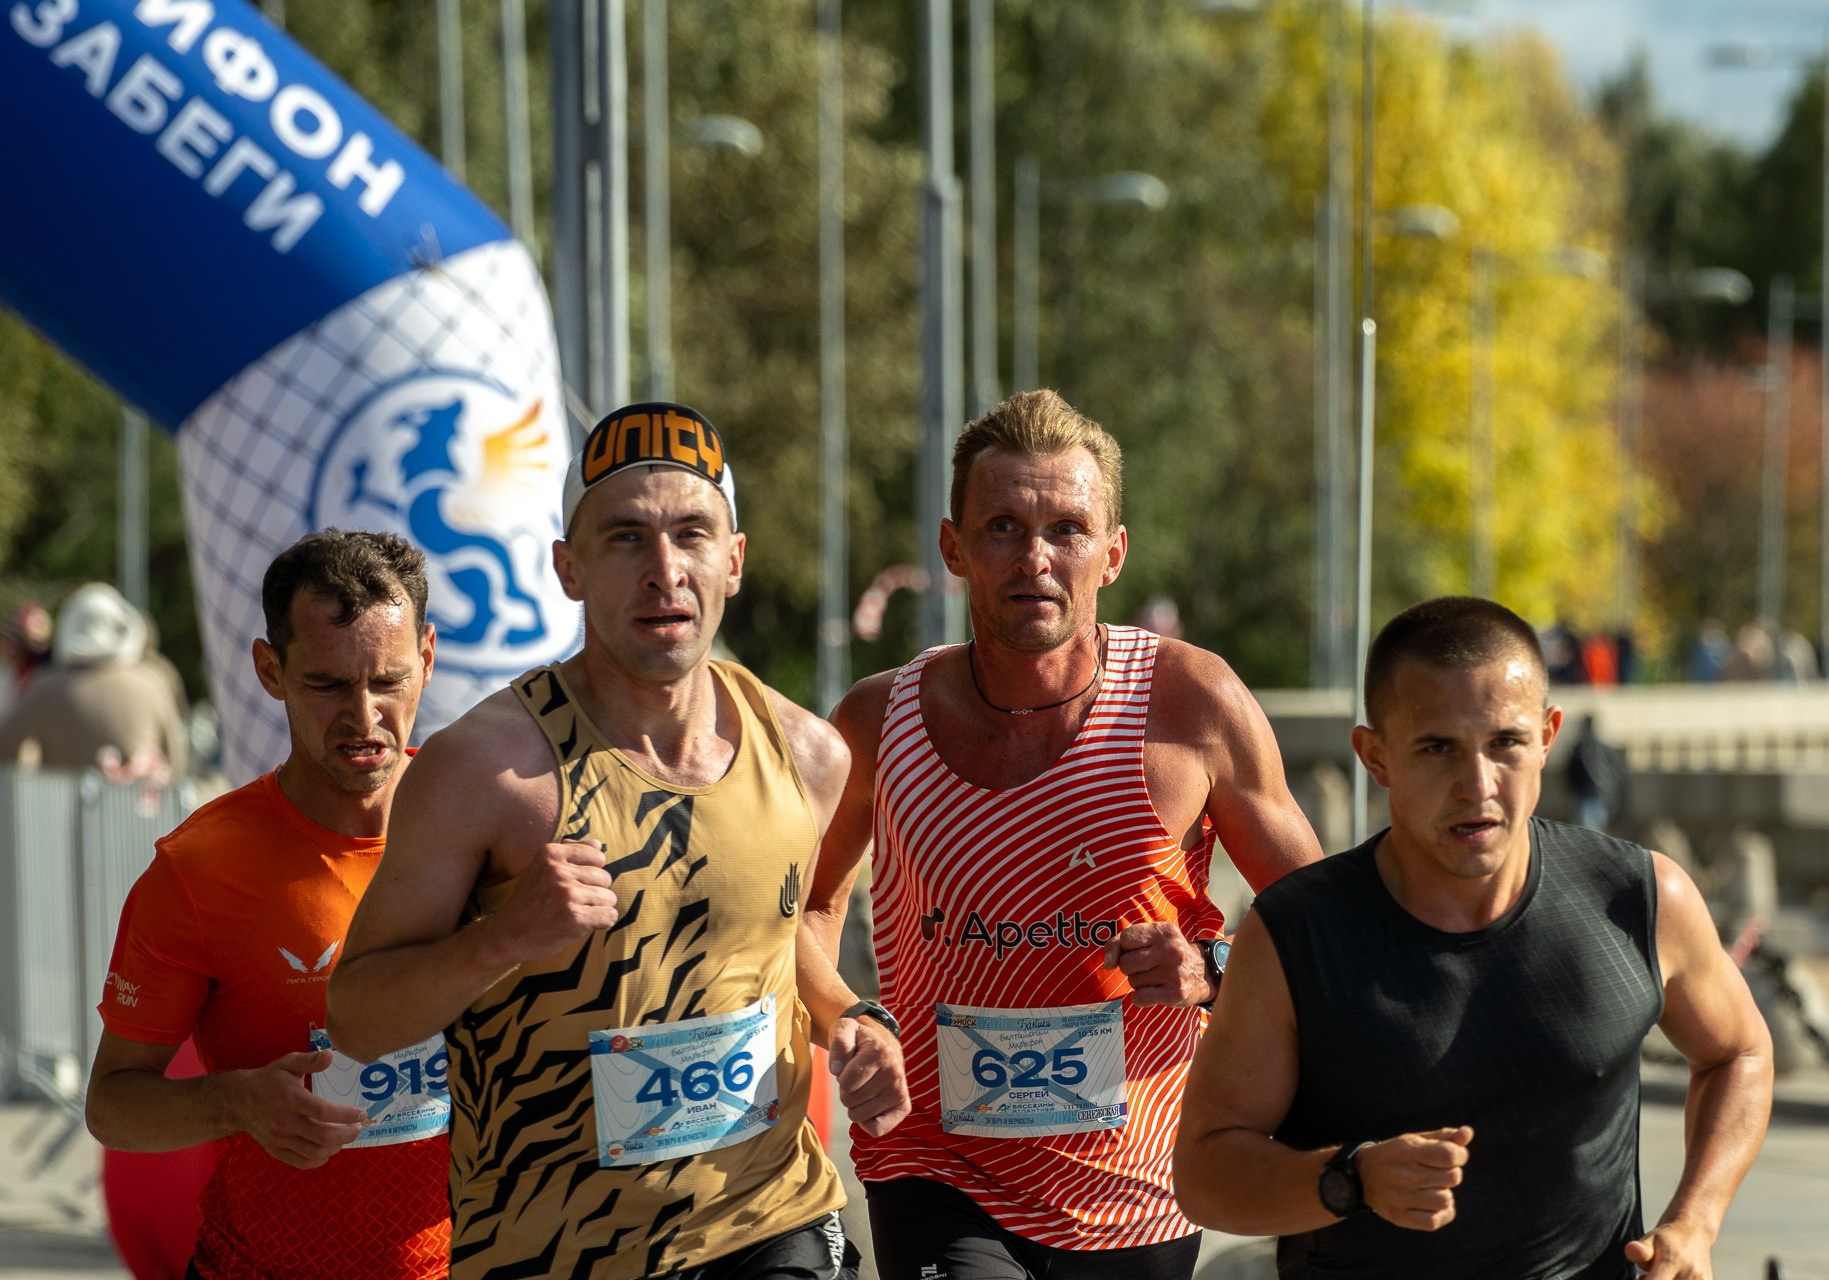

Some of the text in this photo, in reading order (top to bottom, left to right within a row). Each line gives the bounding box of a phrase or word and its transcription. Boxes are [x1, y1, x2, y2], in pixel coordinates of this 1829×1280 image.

[10, 0, 325, 254] ЗАБЕГИ
[960, 910, 1117, 961] Apetta
[117, 992, 138, 1008] RUN
[1078, 1029, 1098, 1038] 10.55
[360, 1052, 448, 1101] 919
[636, 1051, 754, 1107] 466
[972, 1047, 1088, 1088] 625
[687, 1103, 717, 1114] ИВАН
[1009, 1090, 1049, 1099] СЕРГЕЙ
[1077, 1105, 1119, 1121] СЕНЕЖСКАЯ
